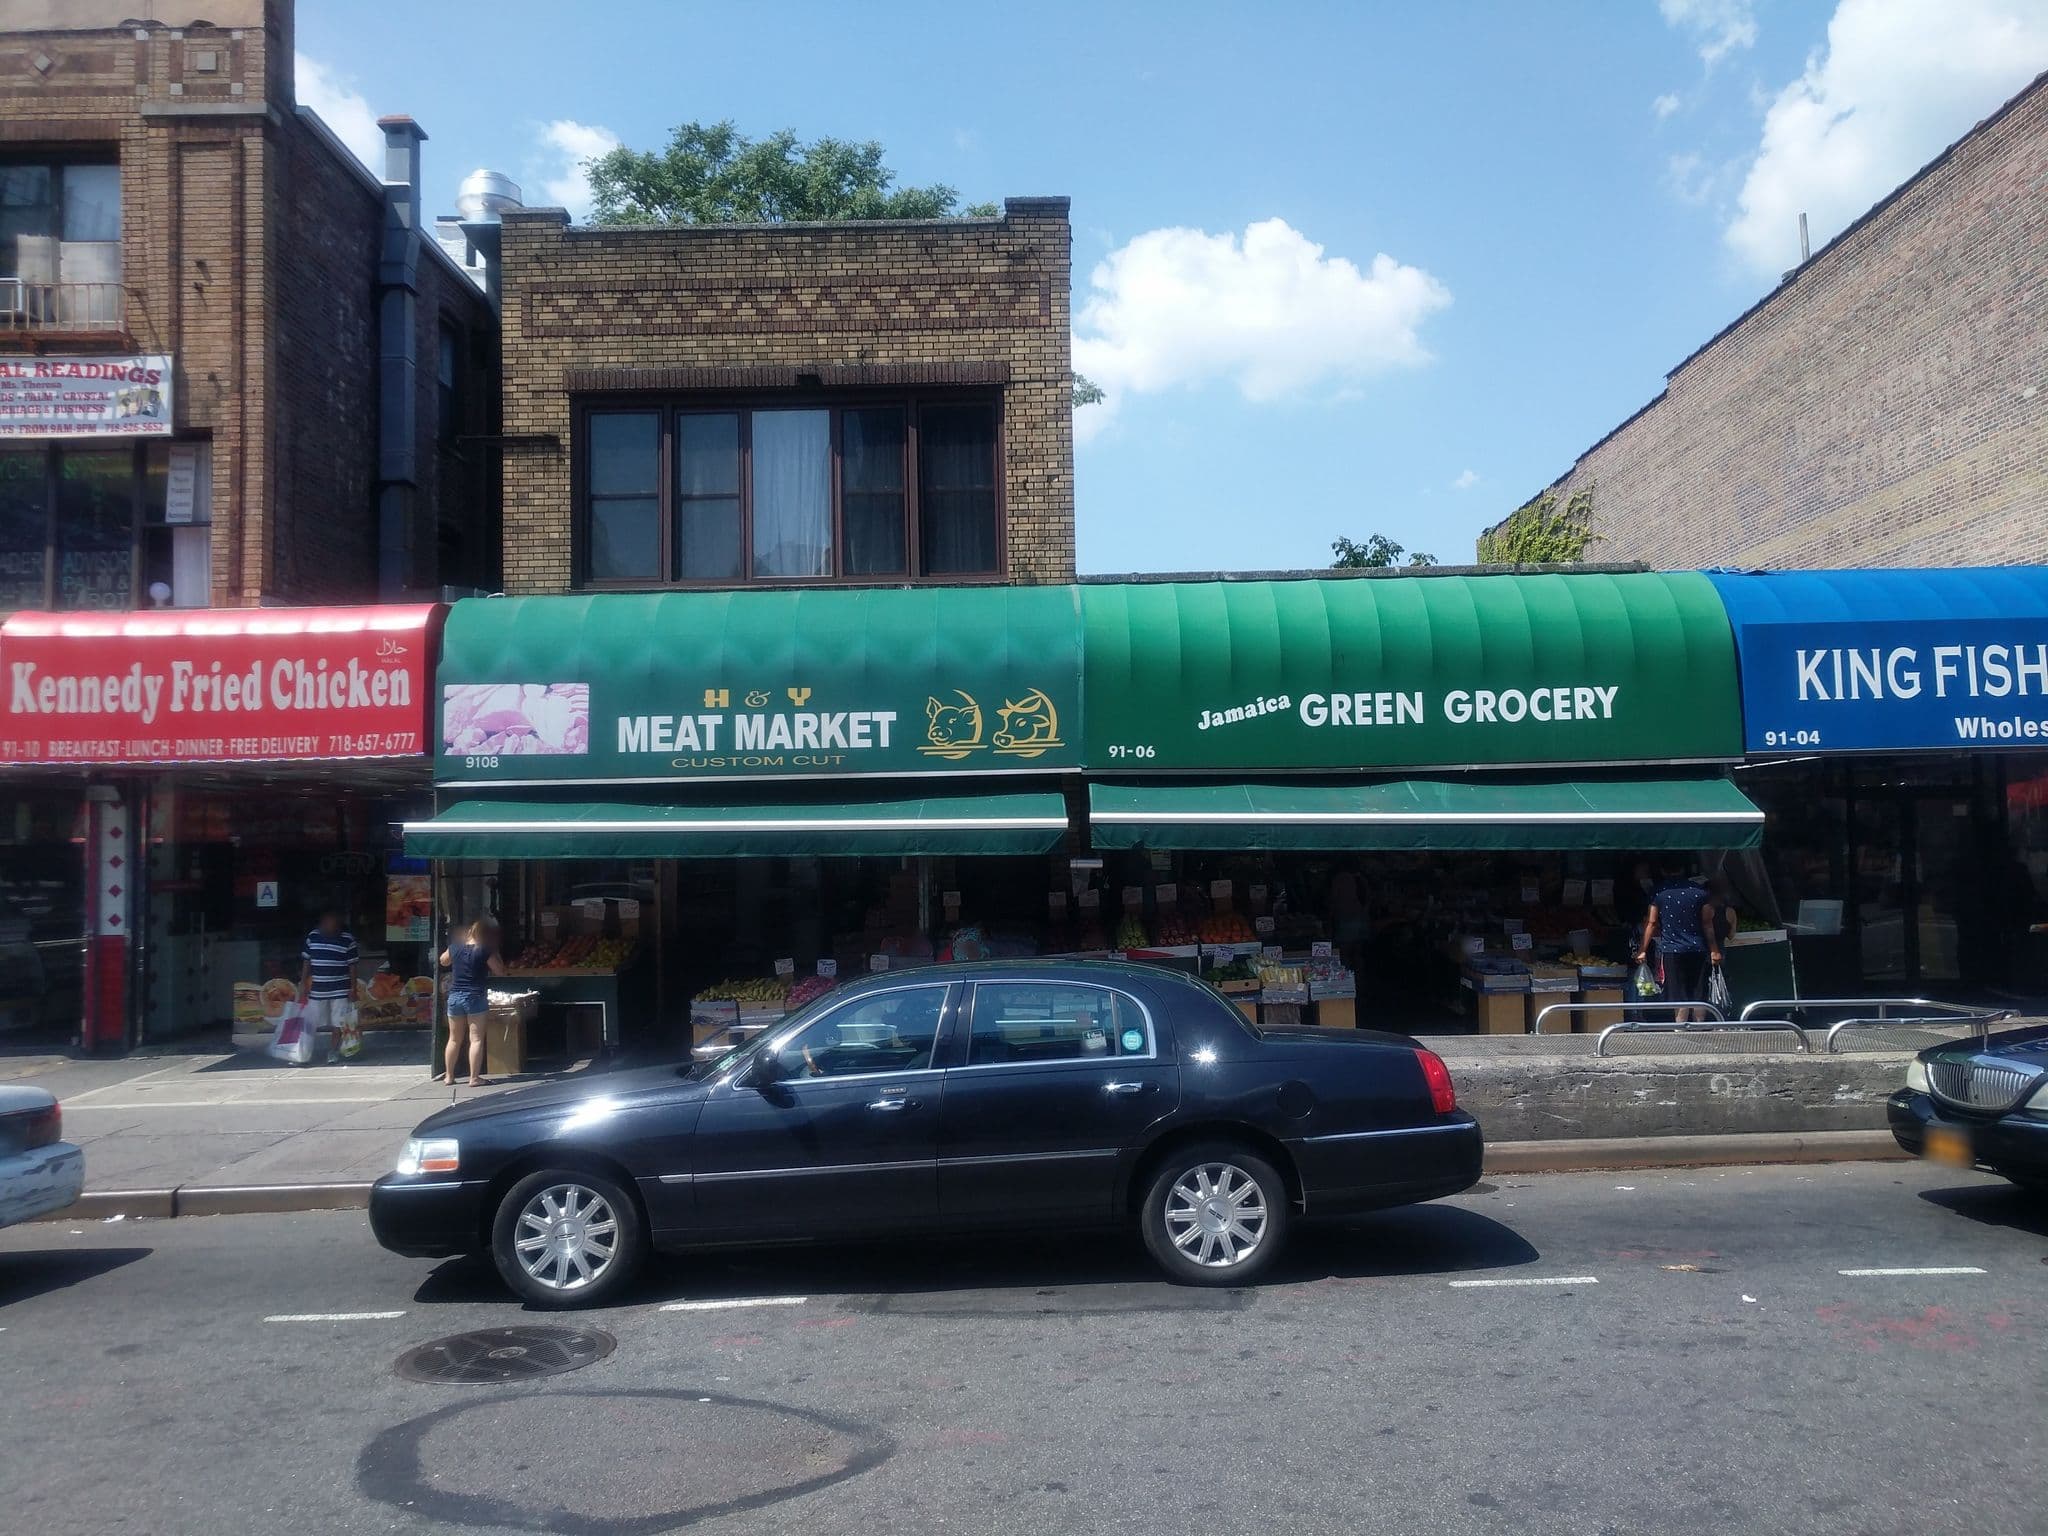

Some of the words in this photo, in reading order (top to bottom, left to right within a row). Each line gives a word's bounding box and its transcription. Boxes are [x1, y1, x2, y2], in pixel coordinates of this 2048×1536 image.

[34, 362, 162, 385] READINGS
[24, 392, 54, 401] PALM
[62, 391, 112, 401] CRYSTAL
[53, 403, 106, 414] BUSINESS
[19, 424, 49, 434] FROM
[376, 637, 408, 656] حلال
[1796, 646, 1922, 701] KING
[1932, 643, 2048, 698] FISH
[9, 661, 163, 724] Kennedy
[169, 660, 263, 713] Fried
[270, 657, 411, 711] Chicken
[703, 688, 730, 708] H
[745, 690, 771, 708] &
[787, 687, 812, 706] Y
[1197, 693, 1292, 731] Jamaica
[1299, 691, 1425, 728] GREEN
[1443, 685, 1619, 724] GROCERY
[617, 715, 723, 753] MEAT
[734, 711, 897, 751] MARKET
[1765, 730, 1820, 746] 91-04
[261, 735, 320, 754] DELIVERY
[328, 732, 416, 752] 718-657-6777
[1108, 745, 1156, 759] 91-06
[465, 756, 500, 769] 9108
[671, 755, 785, 769] CUSTOM
[792, 754, 847, 767] CUT
[261, 886, 274, 899] A
